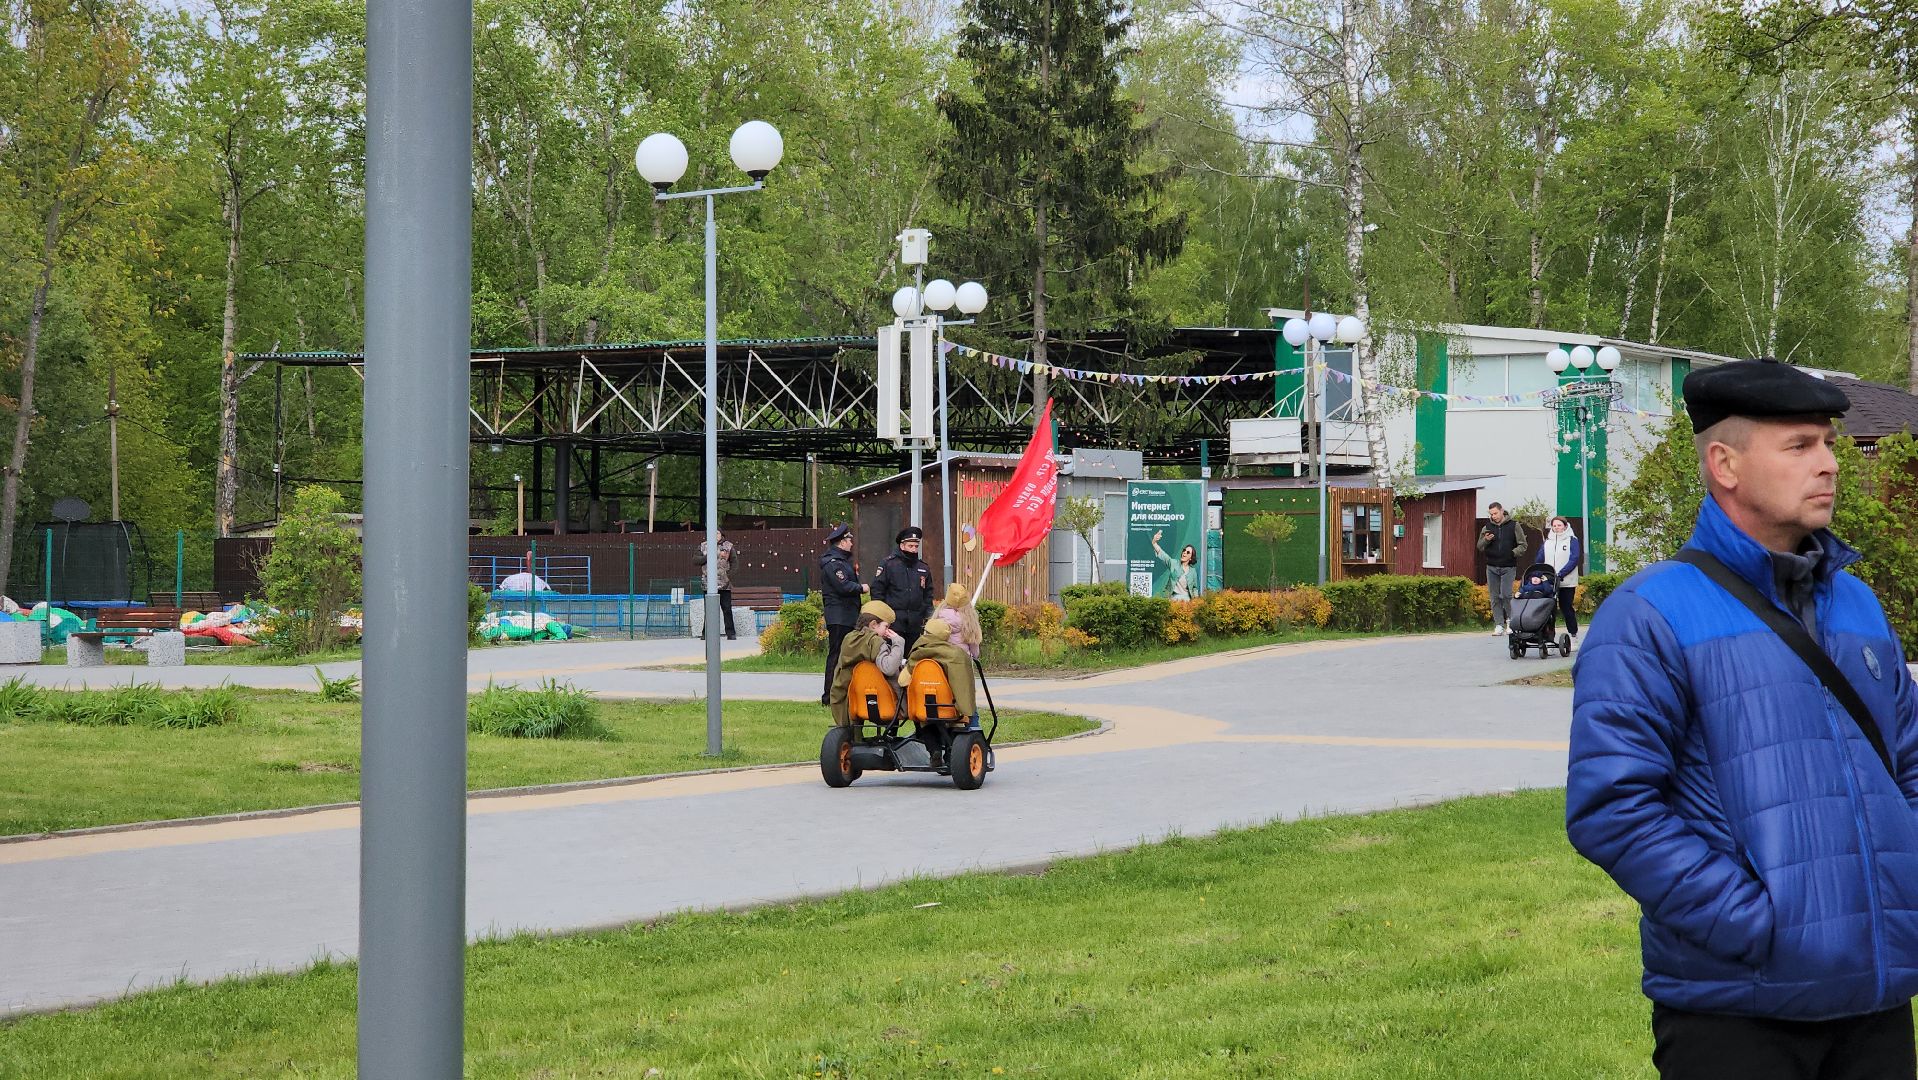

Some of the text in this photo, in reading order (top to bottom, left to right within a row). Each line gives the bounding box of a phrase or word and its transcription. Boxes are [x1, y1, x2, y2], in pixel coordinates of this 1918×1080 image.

[1131, 501, 1171, 512] Интернет
[1131, 513, 1185, 522] для каждого
